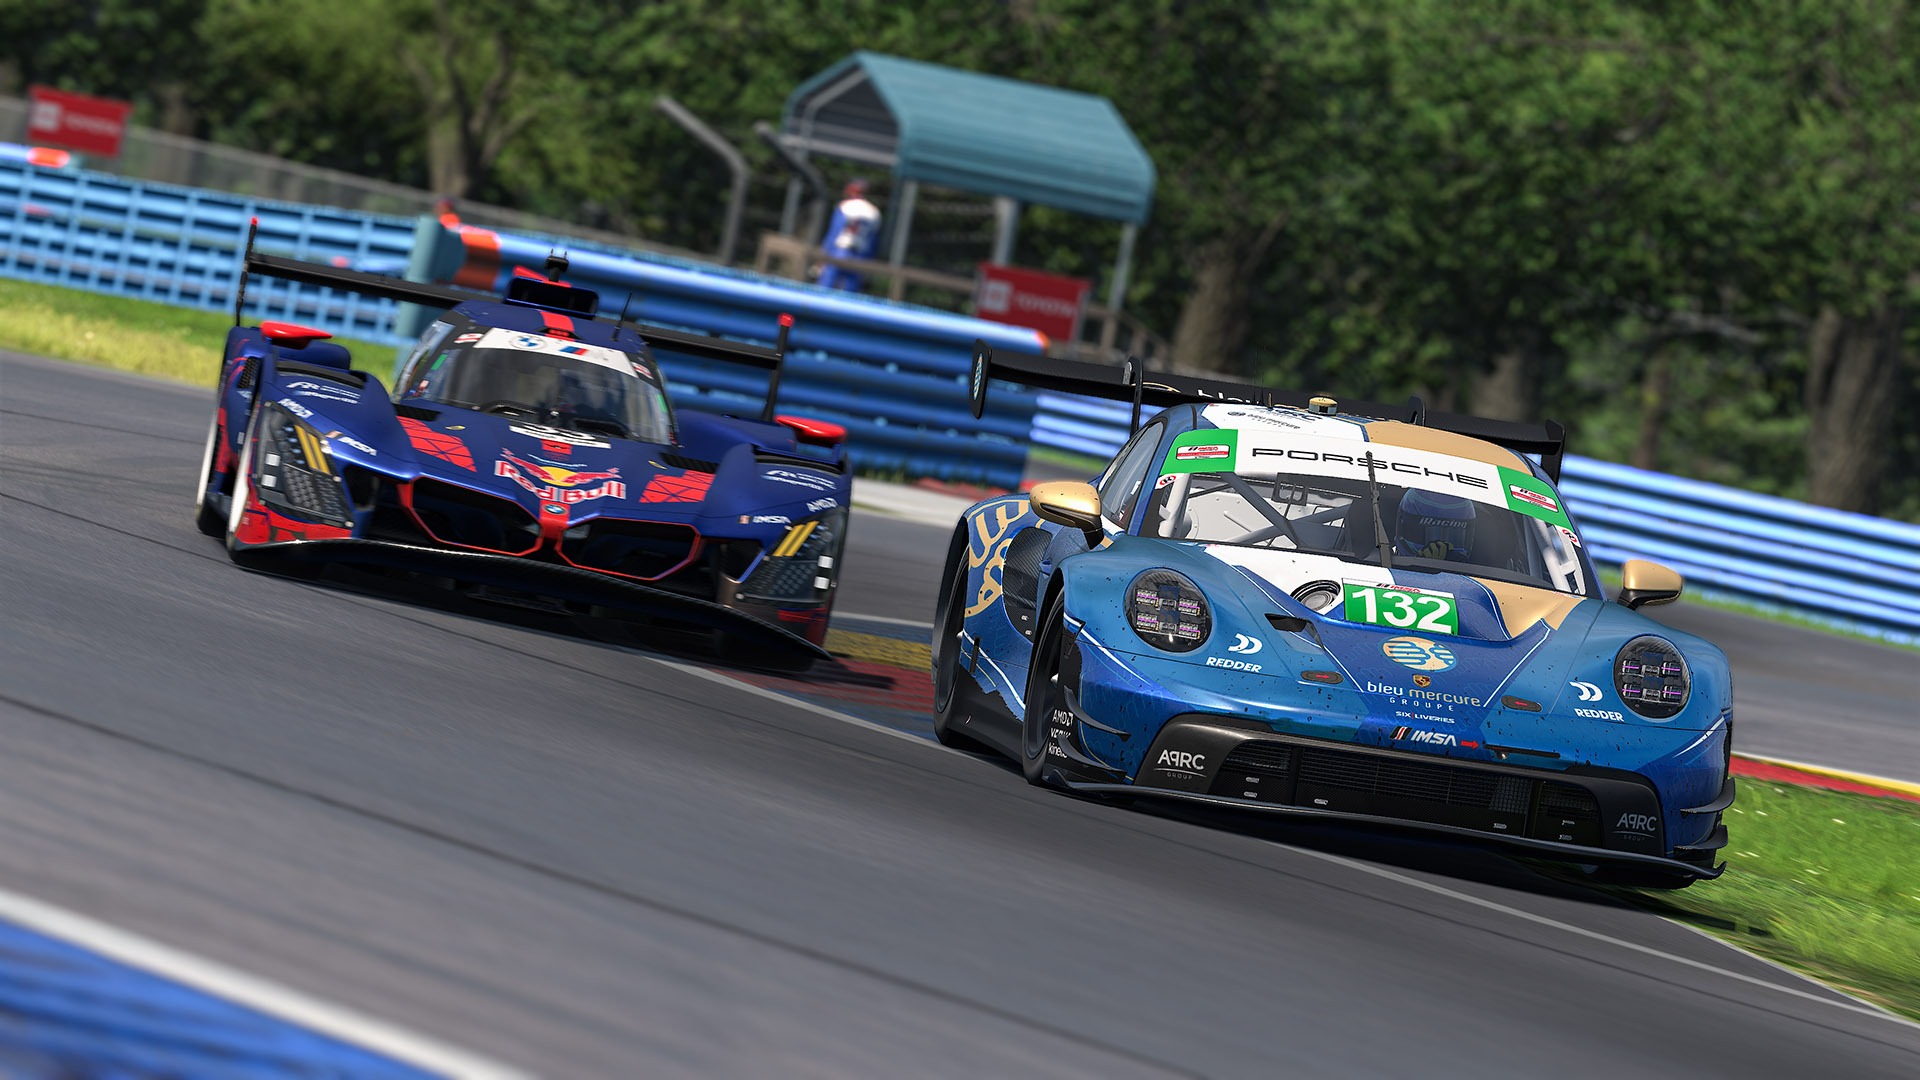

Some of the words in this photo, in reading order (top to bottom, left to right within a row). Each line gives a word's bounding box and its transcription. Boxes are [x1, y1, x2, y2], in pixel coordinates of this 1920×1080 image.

[1252, 447, 1489, 490] PORSCHE
[494, 460, 556, 501] Red
[560, 480, 627, 504] Bull
[1420, 517, 1467, 529] iRacing
[1352, 587, 1452, 634] 132
[1205, 657, 1262, 673] REDDER
[1367, 681, 1403, 696] bleu
[1409, 688, 1481, 707] mercure
[1389, 697, 1454, 712] GROUPE
[1574, 708, 1624, 722] REDDER
[1411, 729, 1457, 747] IMSA
[1167, 771, 1193, 780] GROUP
